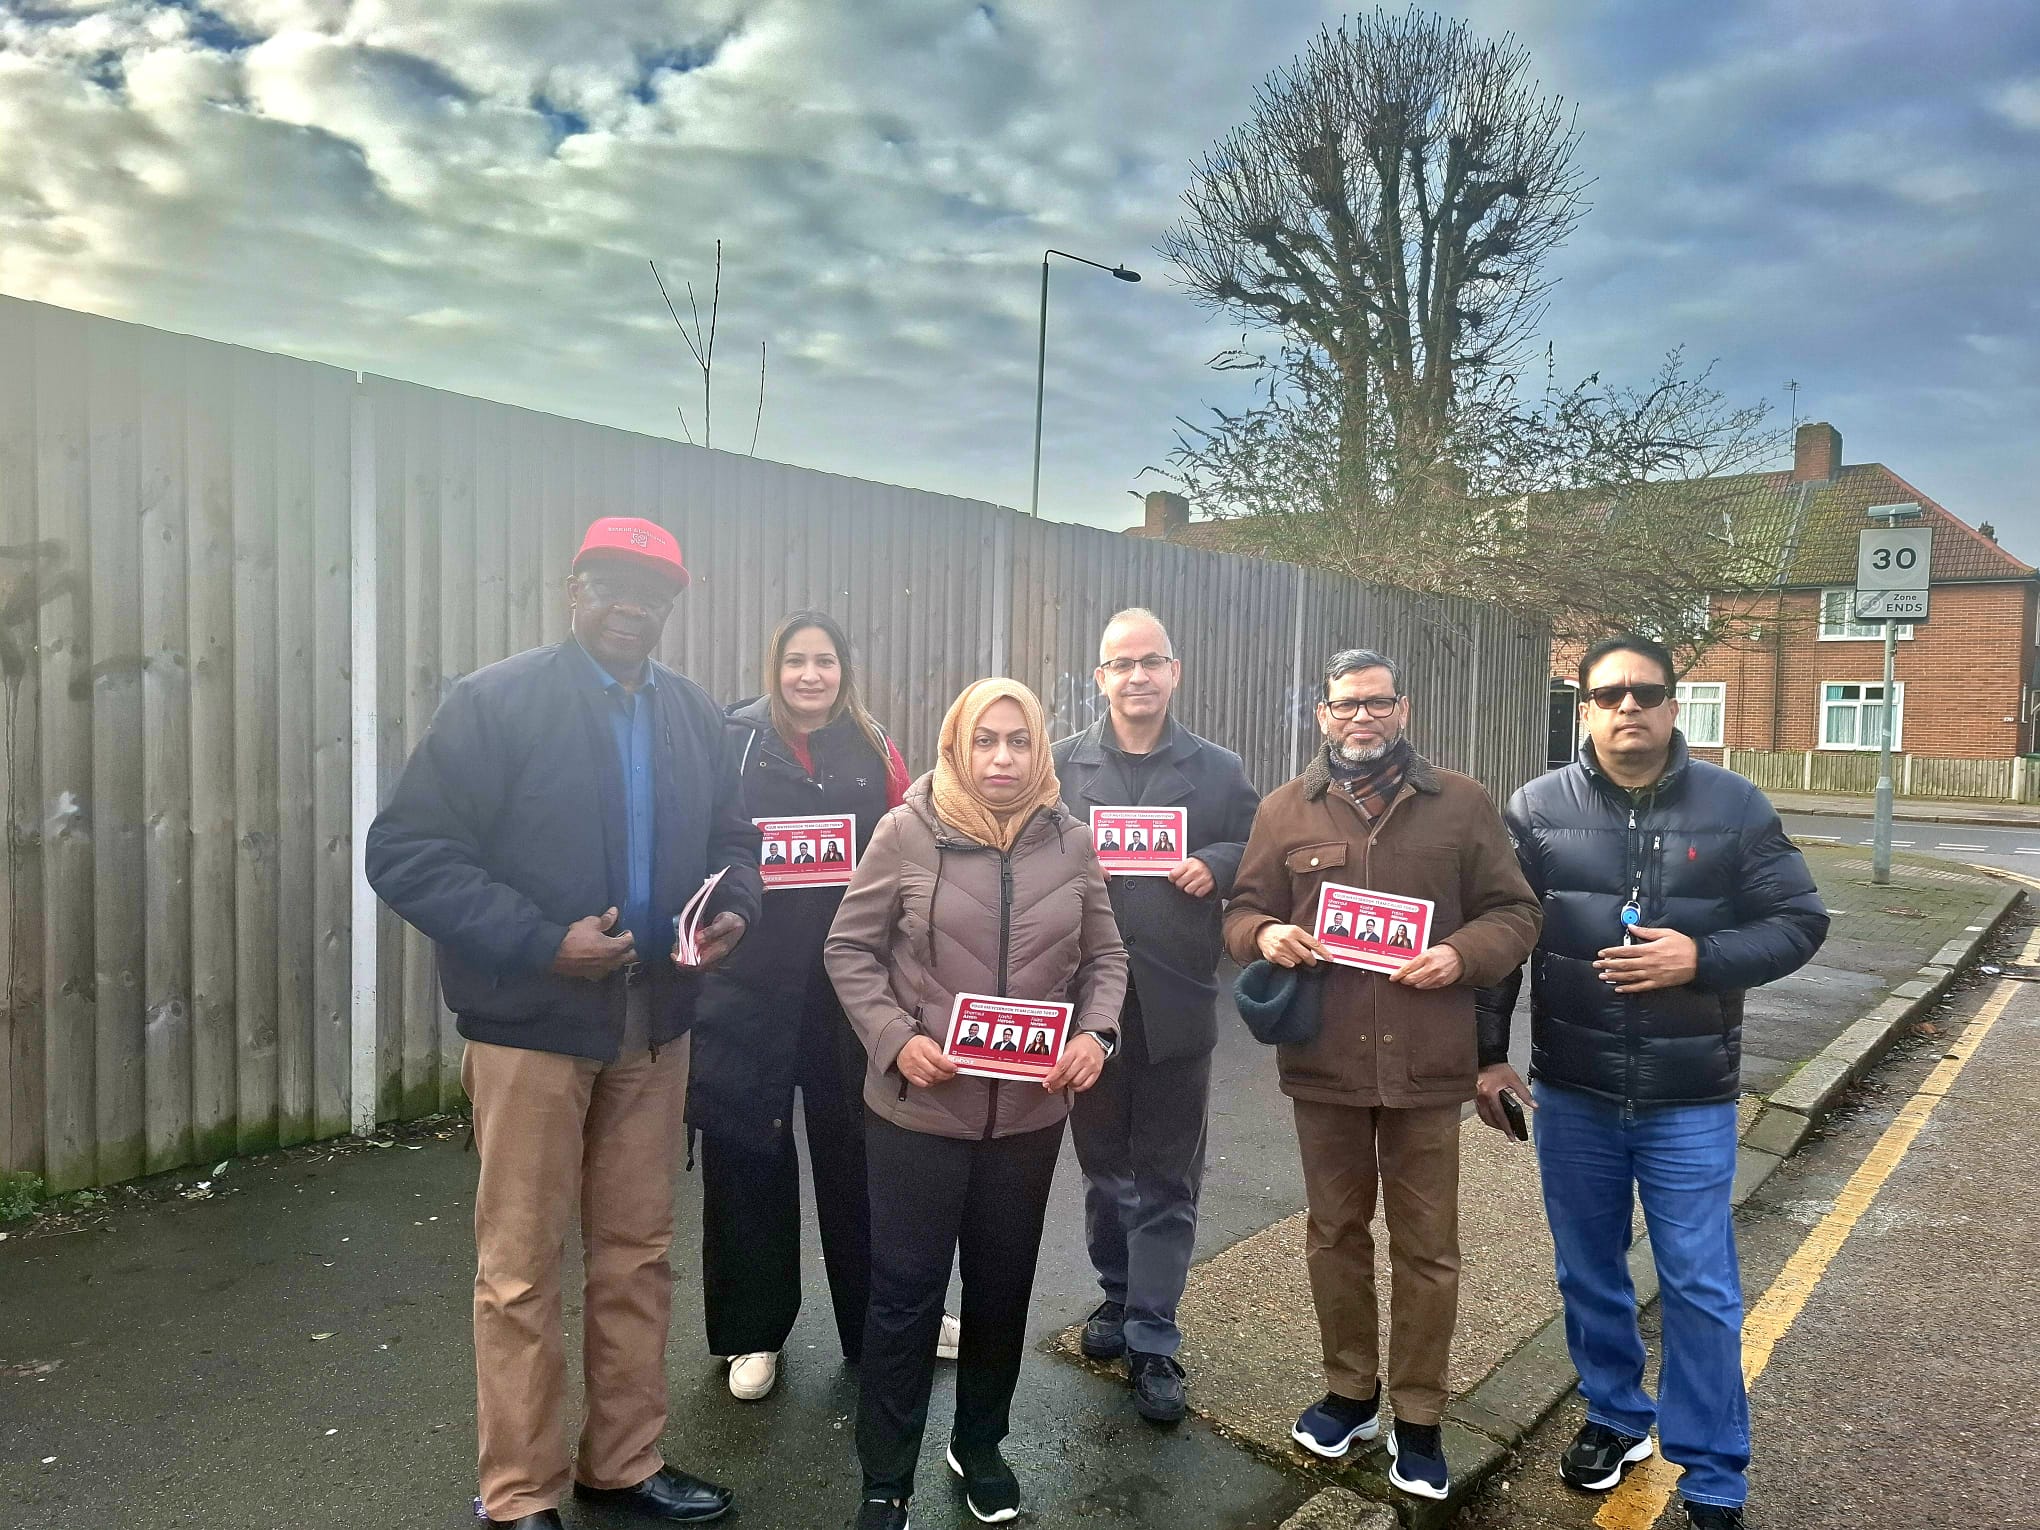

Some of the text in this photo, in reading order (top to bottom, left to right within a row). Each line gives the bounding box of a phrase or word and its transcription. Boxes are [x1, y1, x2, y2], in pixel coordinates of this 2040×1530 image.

[1872, 547, 1917, 570] 30
[1893, 593, 1917, 601] Zone
[1886, 603, 1923, 612] ENDS
